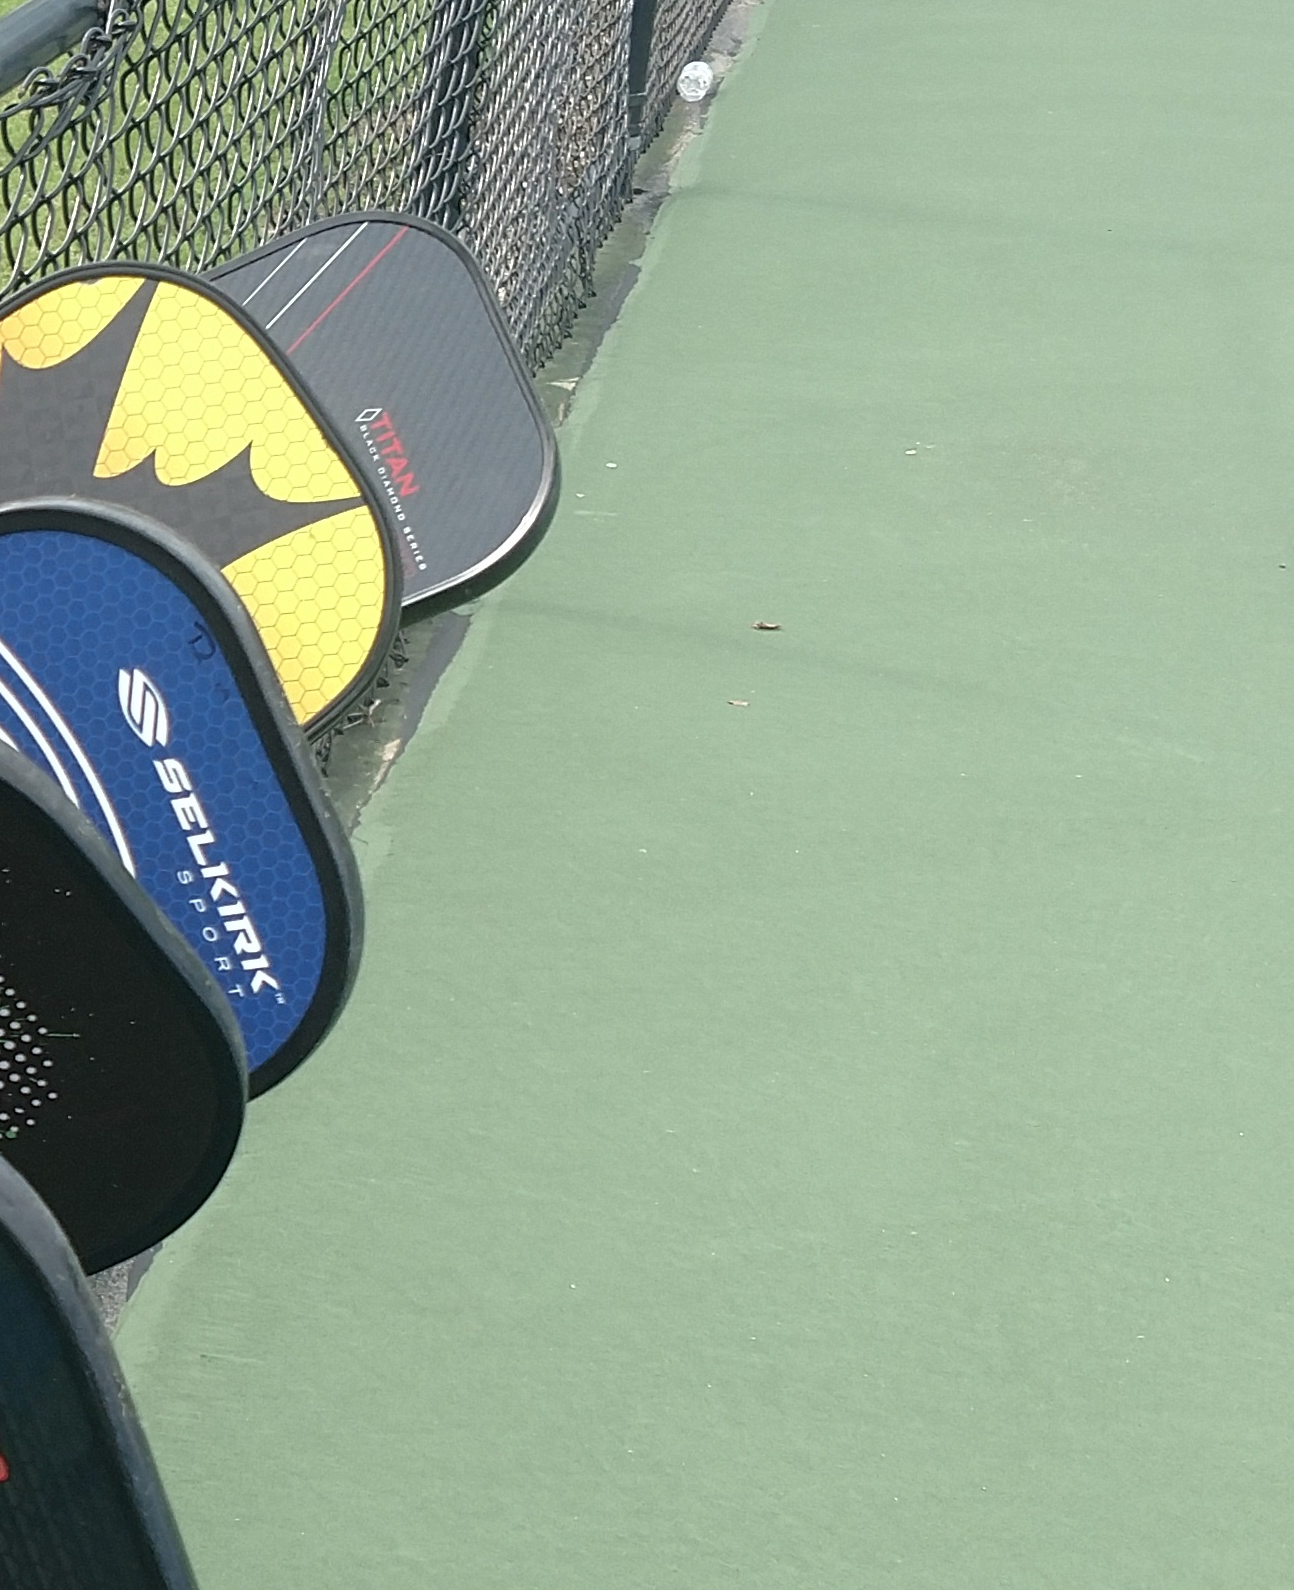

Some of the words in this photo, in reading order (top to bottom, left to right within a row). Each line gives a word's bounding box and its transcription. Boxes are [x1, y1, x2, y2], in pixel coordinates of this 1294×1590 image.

[359, 424, 380, 462] BLACK
[377, 466, 406, 522] DIAMOND
[402, 526, 428, 571] SERIES
[369, 411, 421, 498] TITAN
[176, 869, 246, 998] SPORT
